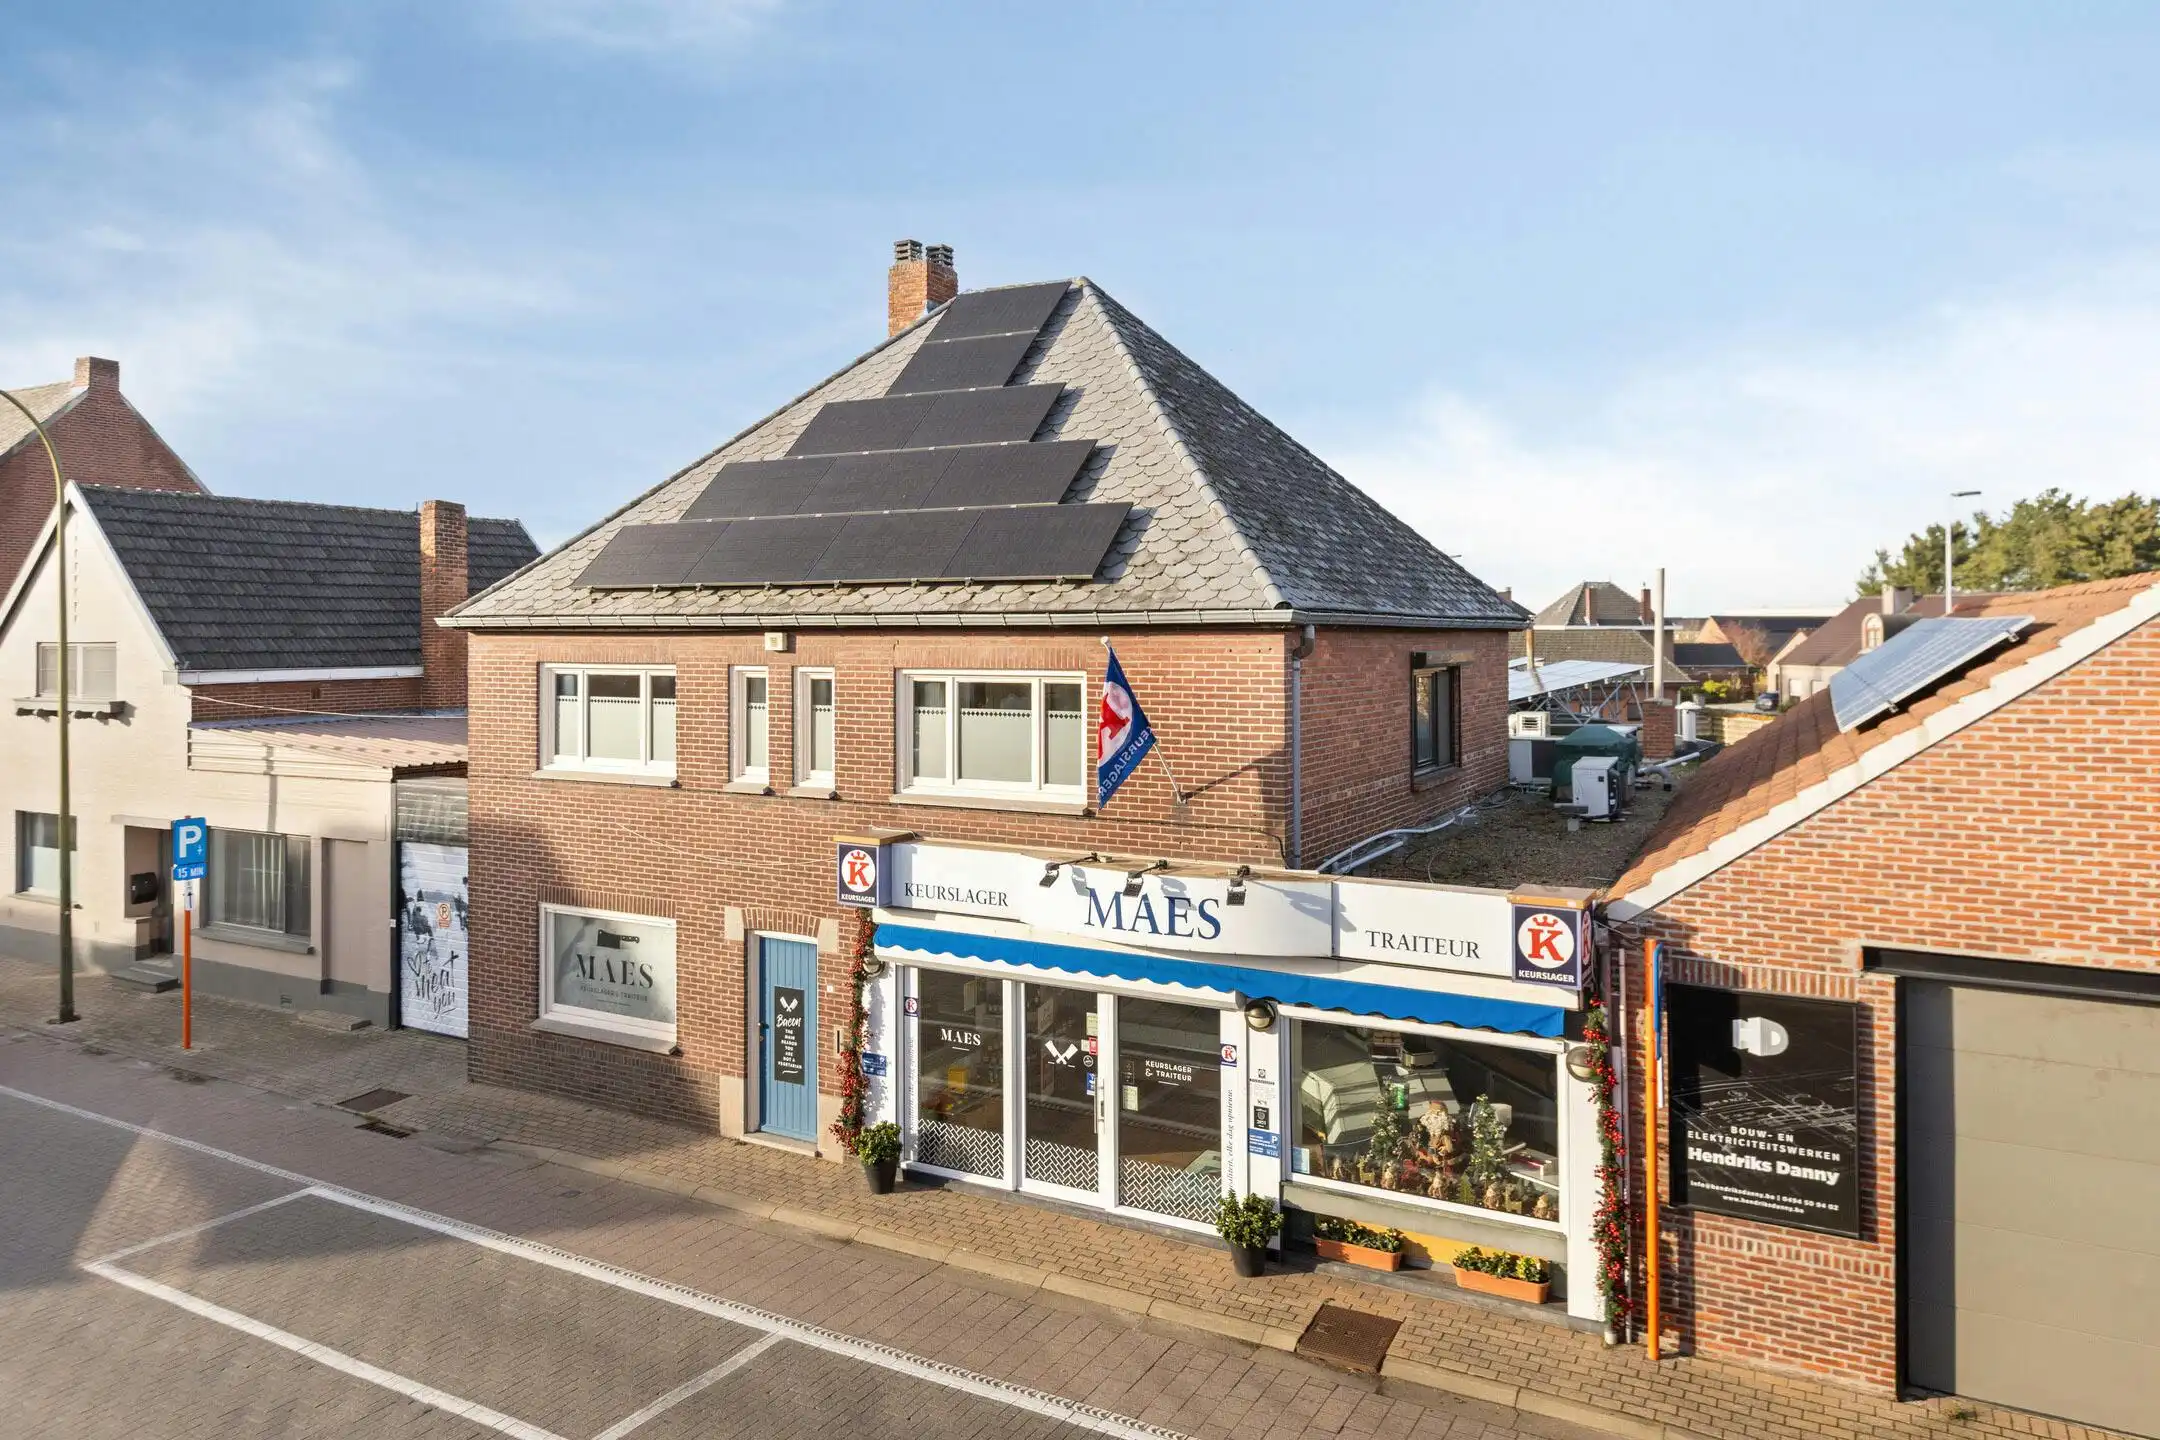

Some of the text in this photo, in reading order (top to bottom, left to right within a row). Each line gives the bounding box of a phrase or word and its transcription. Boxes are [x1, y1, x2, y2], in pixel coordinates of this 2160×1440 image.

[180, 825, 202, 858] P
[177, 866, 204, 878] 15 MIN
[848, 861, 869, 886] K
[841, 894, 875, 903] KEURSLAGER
[904, 882, 1009, 907] KEURSLAGER
[1084, 887, 1222, 940] MAES
[1365, 930, 1482, 960] TRAITEUR
[1528, 928, 1564, 961] K
[576, 953, 654, 988] MAES
[1518, 970, 1575, 983] KEURSLAGER
[941, 1028, 981, 1046] MAES
[1145, 1060, 1192, 1073] KEURSLAGER
[1145, 1068, 1153, 1077] &
[1156, 1070, 1192, 1082] TRAITEUR
[1688, 1130, 1840, 1161] ELEKTRICITEITSWERKEN
[1731, 1126, 1794, 1142] BOUW- EN
[1688, 1147, 1840, 1186] Hendriks Danny
